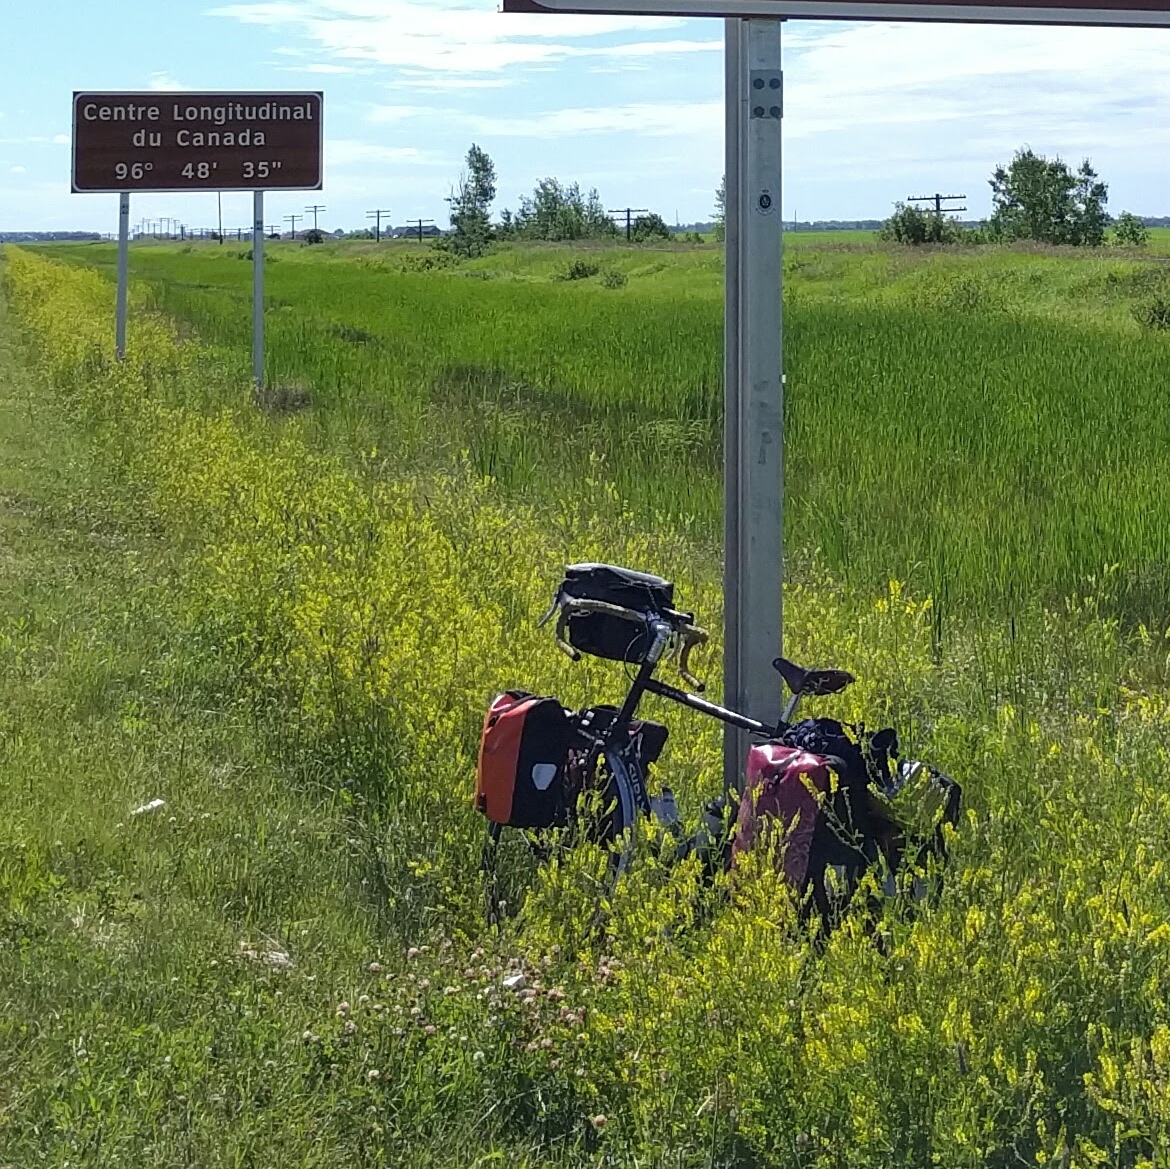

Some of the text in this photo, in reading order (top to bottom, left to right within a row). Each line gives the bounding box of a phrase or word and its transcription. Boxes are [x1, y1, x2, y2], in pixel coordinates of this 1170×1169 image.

[84, 102, 313, 125] Centre Longitudinal
[132, 129, 266, 147] du Canada
